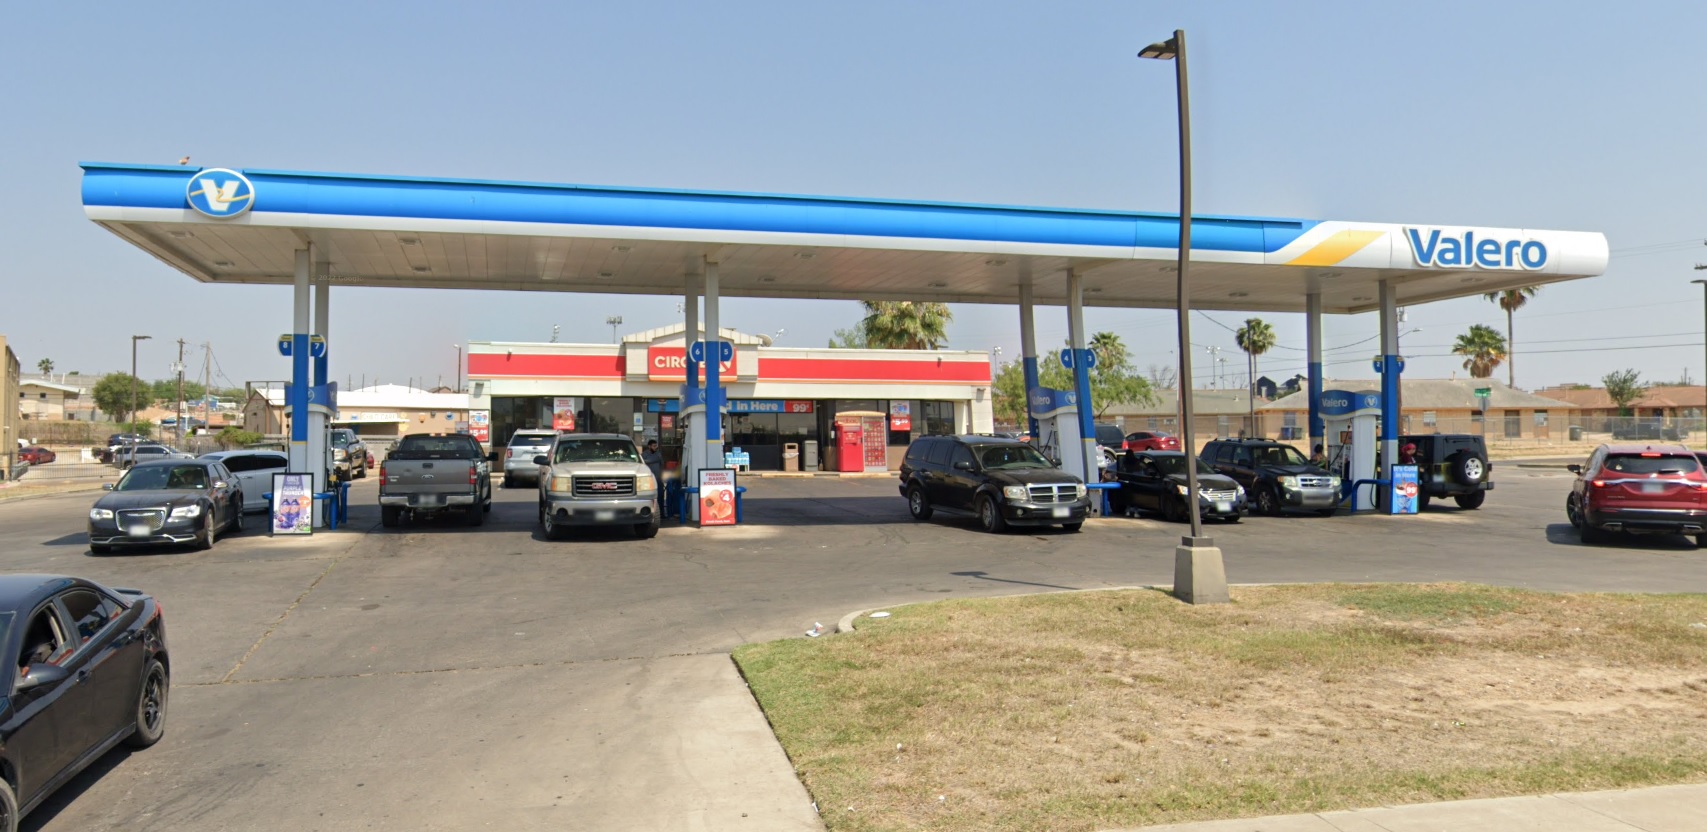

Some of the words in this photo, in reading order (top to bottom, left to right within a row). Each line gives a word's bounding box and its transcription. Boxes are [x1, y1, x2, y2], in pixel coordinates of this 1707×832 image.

[1408, 228, 1547, 269] Valero
[315, 342, 320, 350] 7
[751, 401, 778, 411] Here
[1321, 397, 1348, 407] Valero
[591, 482, 618, 490] GMC
